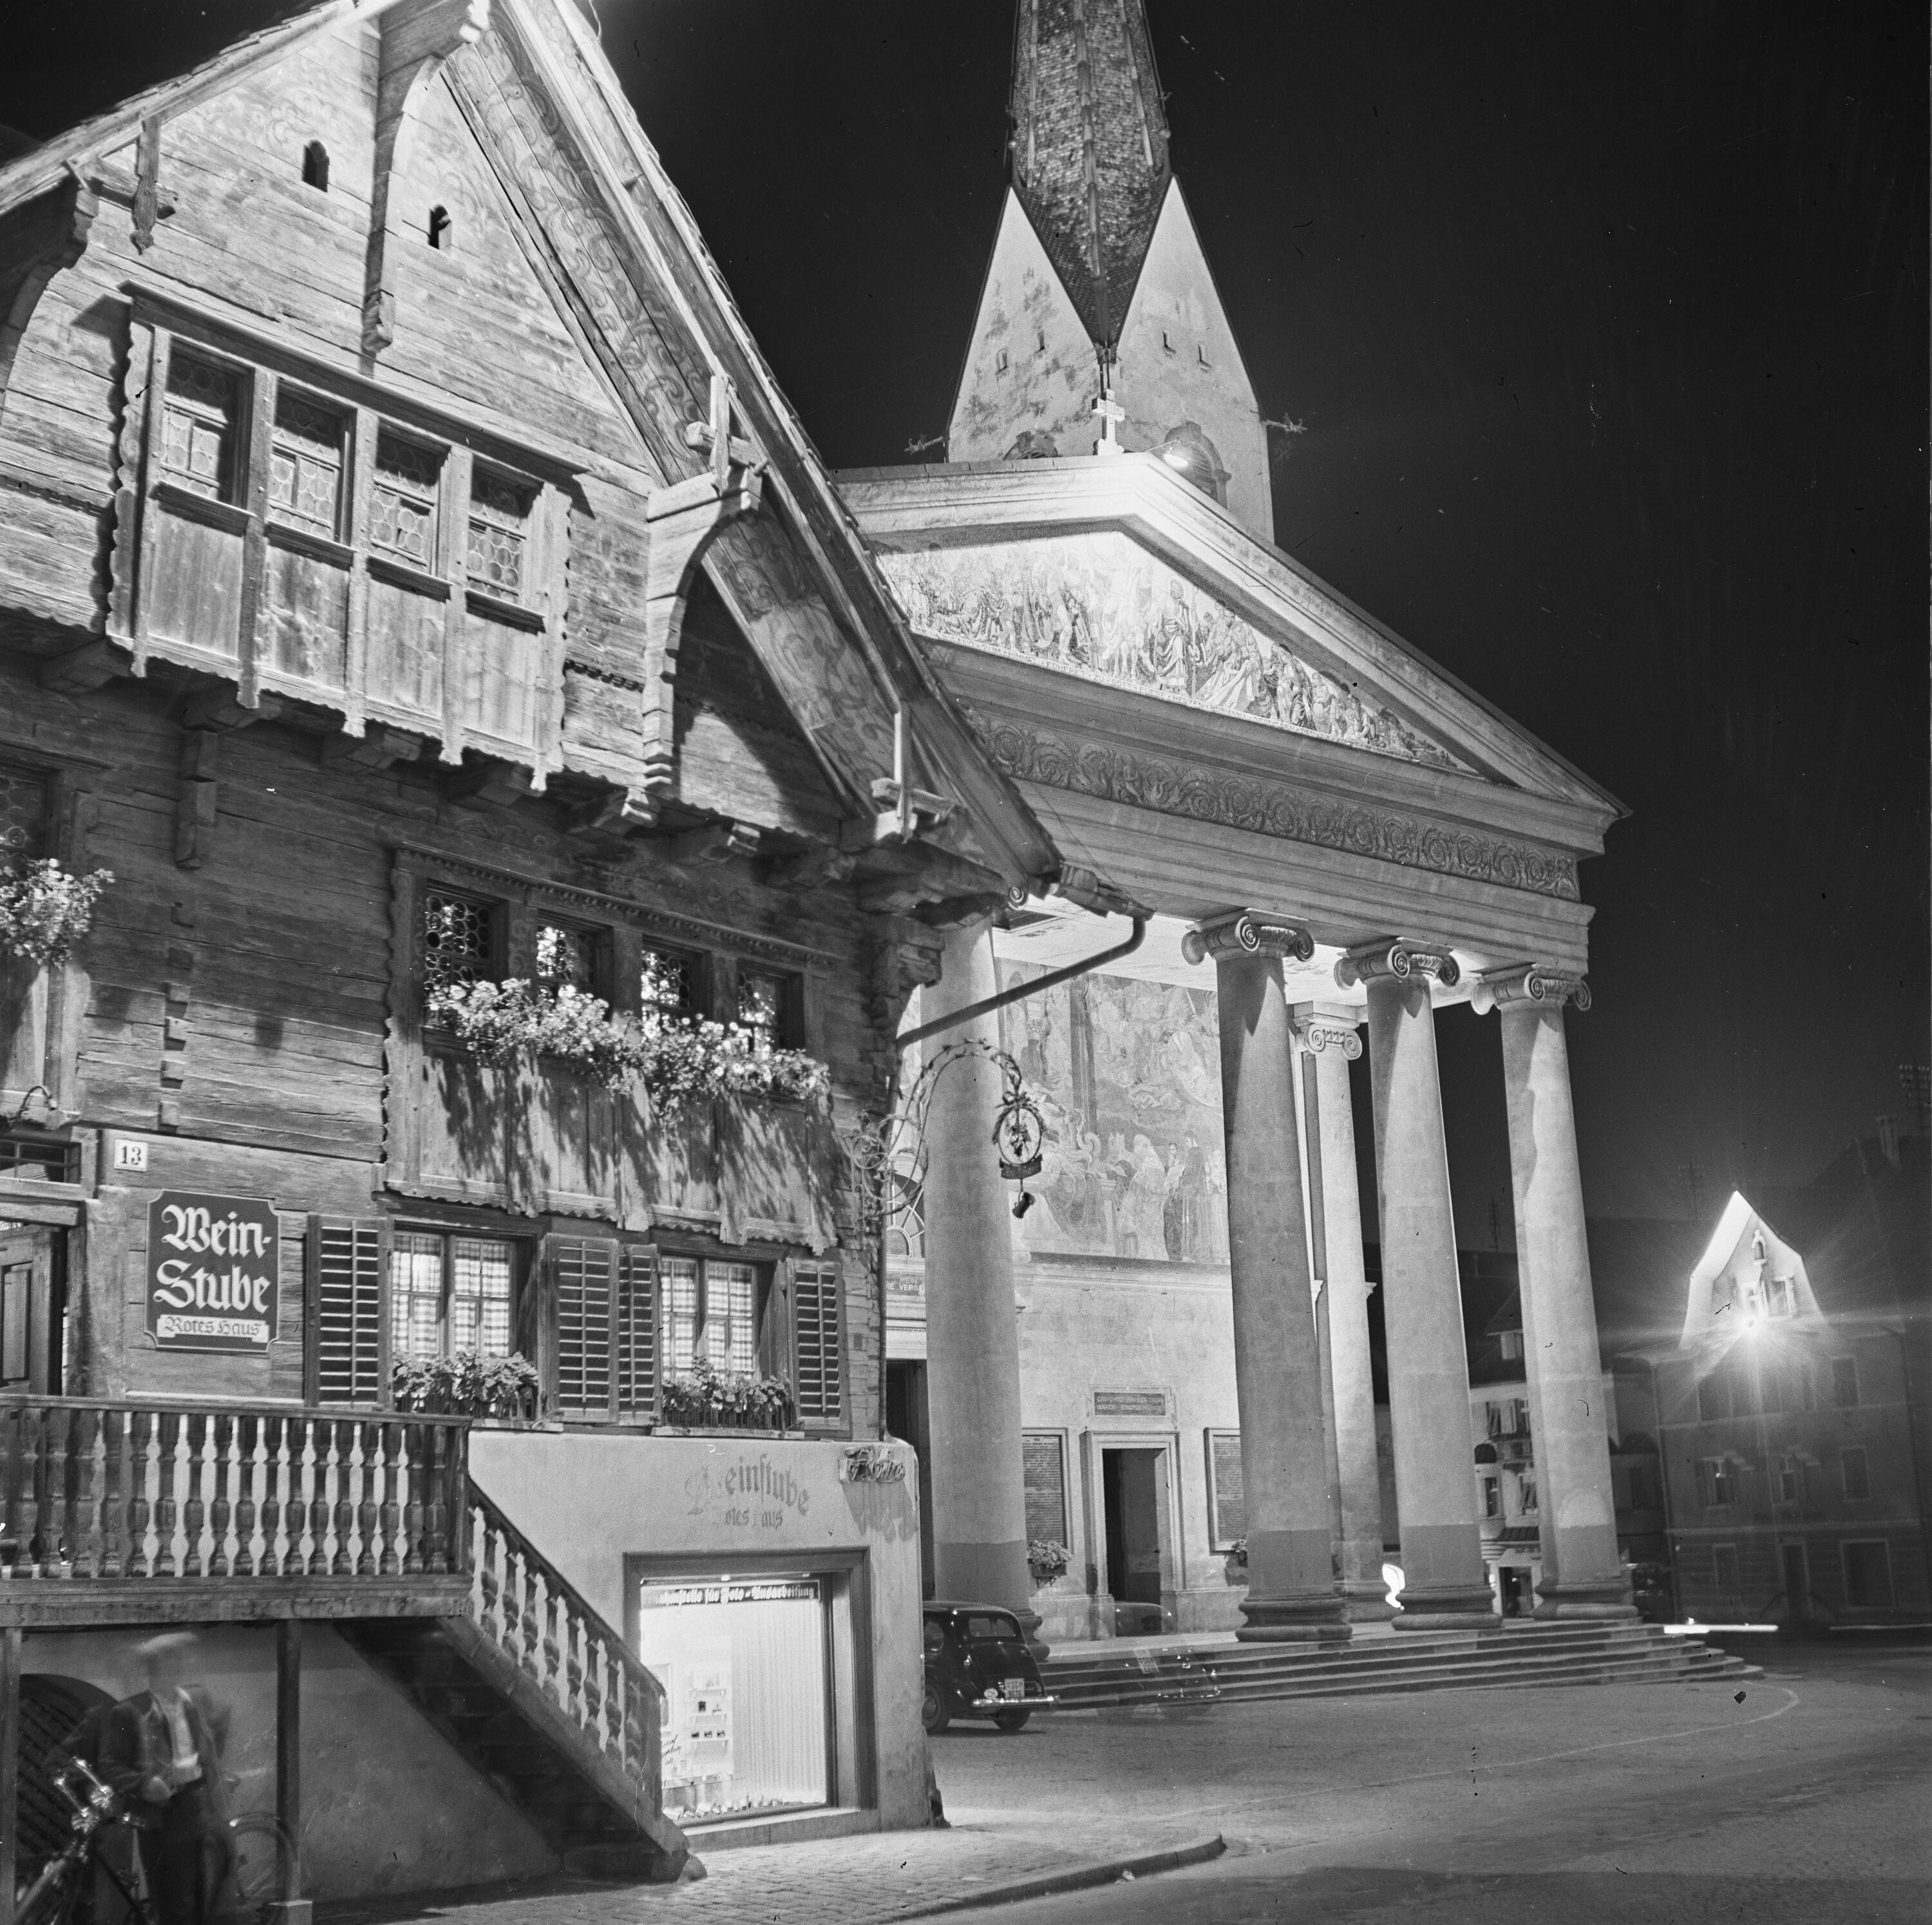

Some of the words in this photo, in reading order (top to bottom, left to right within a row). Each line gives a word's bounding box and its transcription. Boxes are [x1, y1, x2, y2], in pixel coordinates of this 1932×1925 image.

[120, 1146, 142, 1165] 13
[161, 1204, 273, 1258] Wein-
[153, 1258, 271, 1314] Stube
[163, 1316, 214, 1334] Rotes
[217, 1322, 263, 1336] Haus
